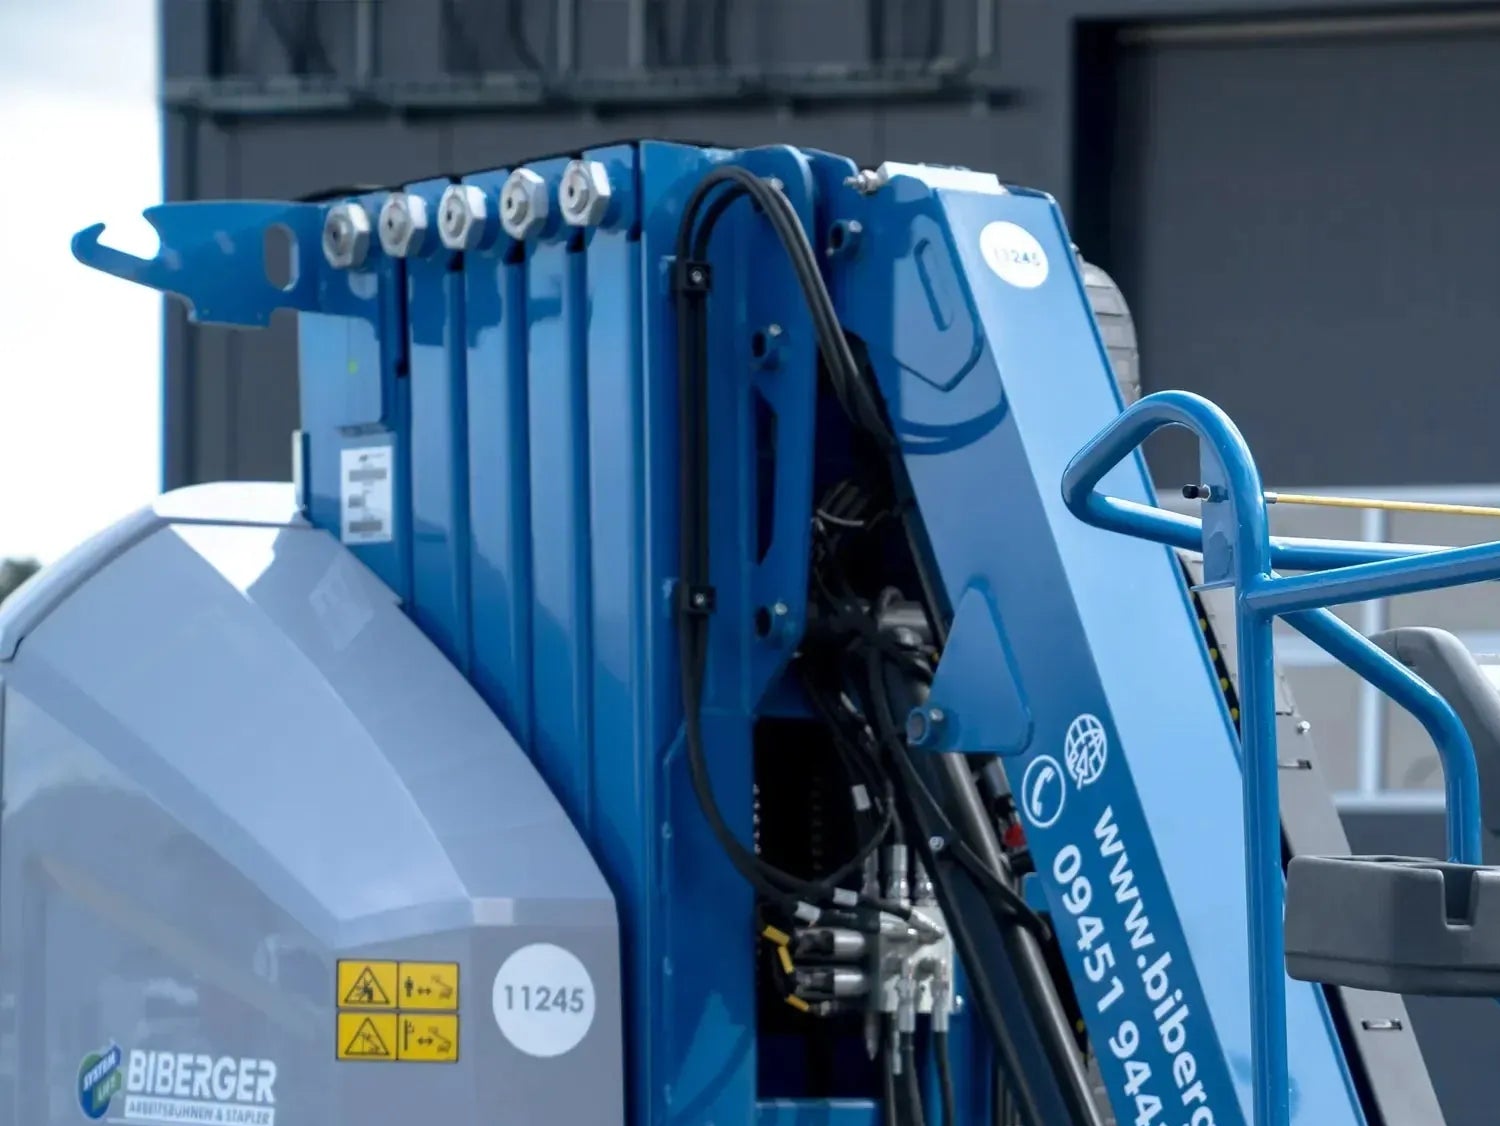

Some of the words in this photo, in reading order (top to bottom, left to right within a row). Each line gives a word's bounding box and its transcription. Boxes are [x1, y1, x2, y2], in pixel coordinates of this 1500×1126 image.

[1052, 844, 1125, 1013] 09451
[504, 985, 584, 1014] 11245
[126, 1049, 277, 1104] BIBERGER
[226, 1109, 270, 1126] STAPLER
